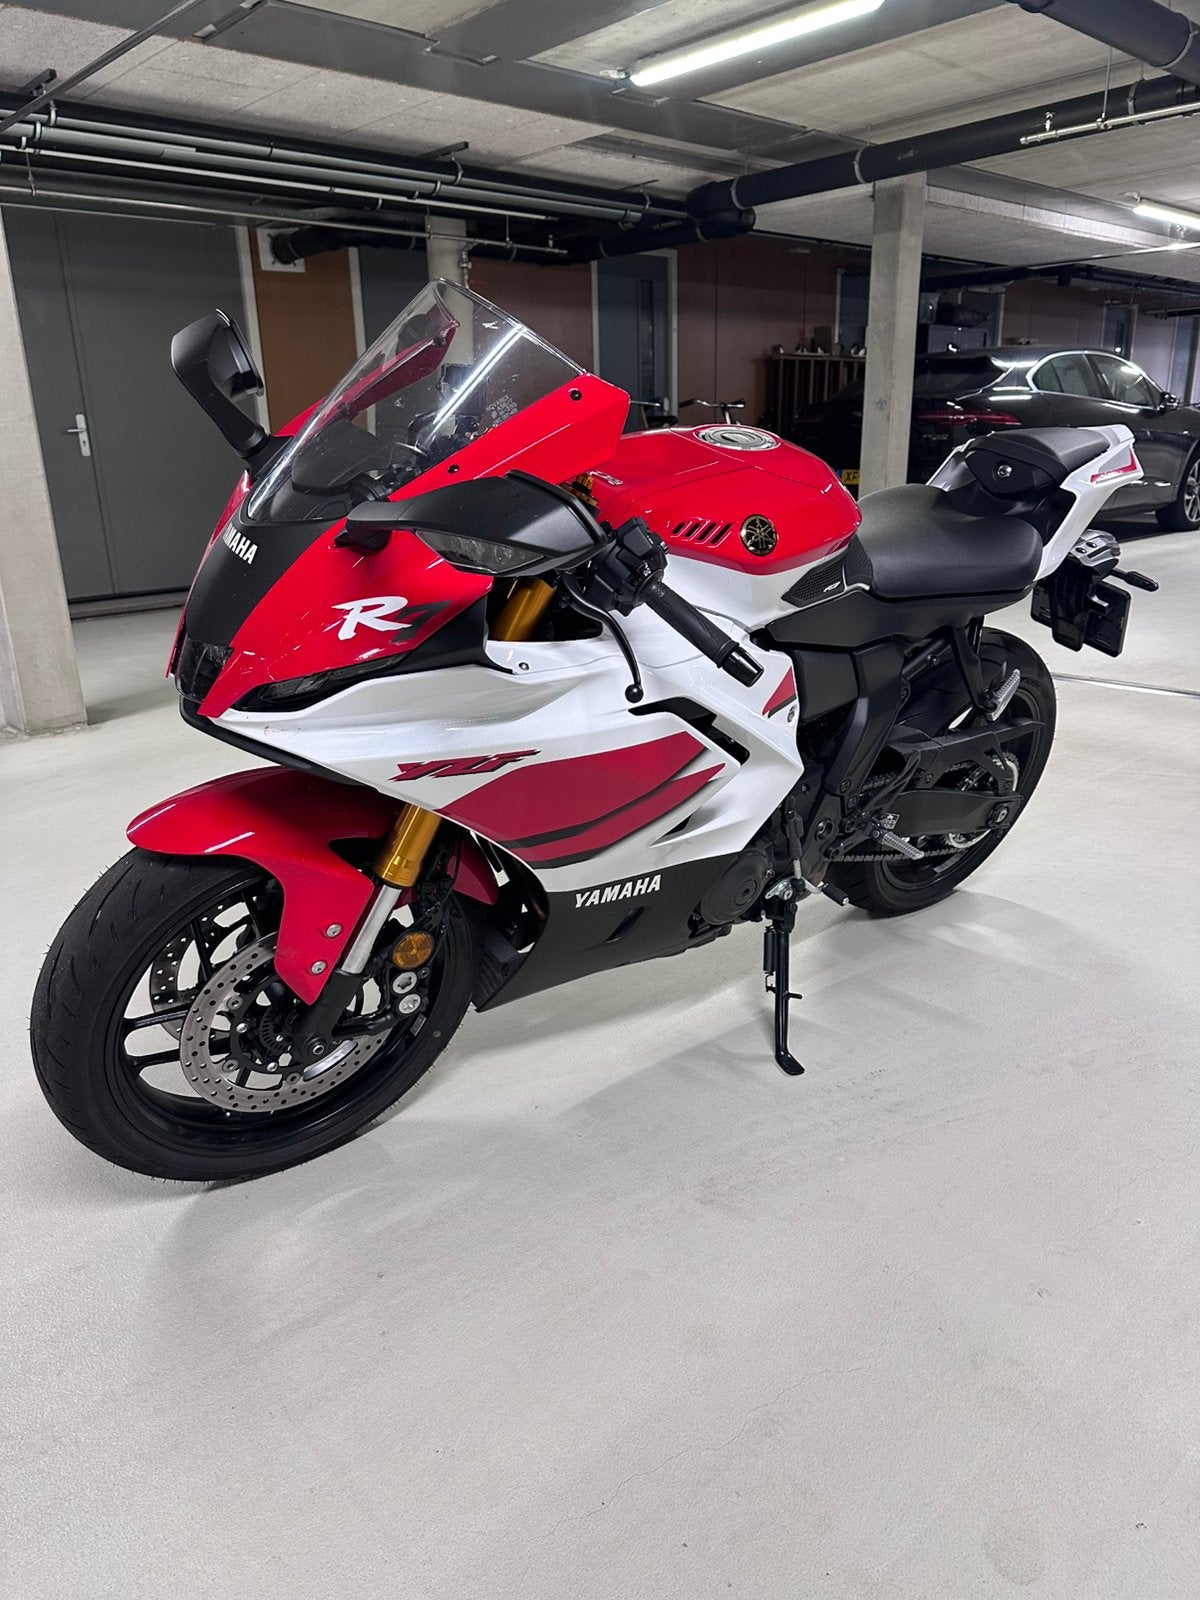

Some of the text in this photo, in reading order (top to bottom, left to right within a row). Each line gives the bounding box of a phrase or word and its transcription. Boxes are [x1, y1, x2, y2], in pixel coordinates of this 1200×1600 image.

[222, 522, 258, 565] AMAHA
[331, 596, 454, 645] R7
[387, 749, 542, 782] YZF
[575, 874, 662, 908] YAMAHA
